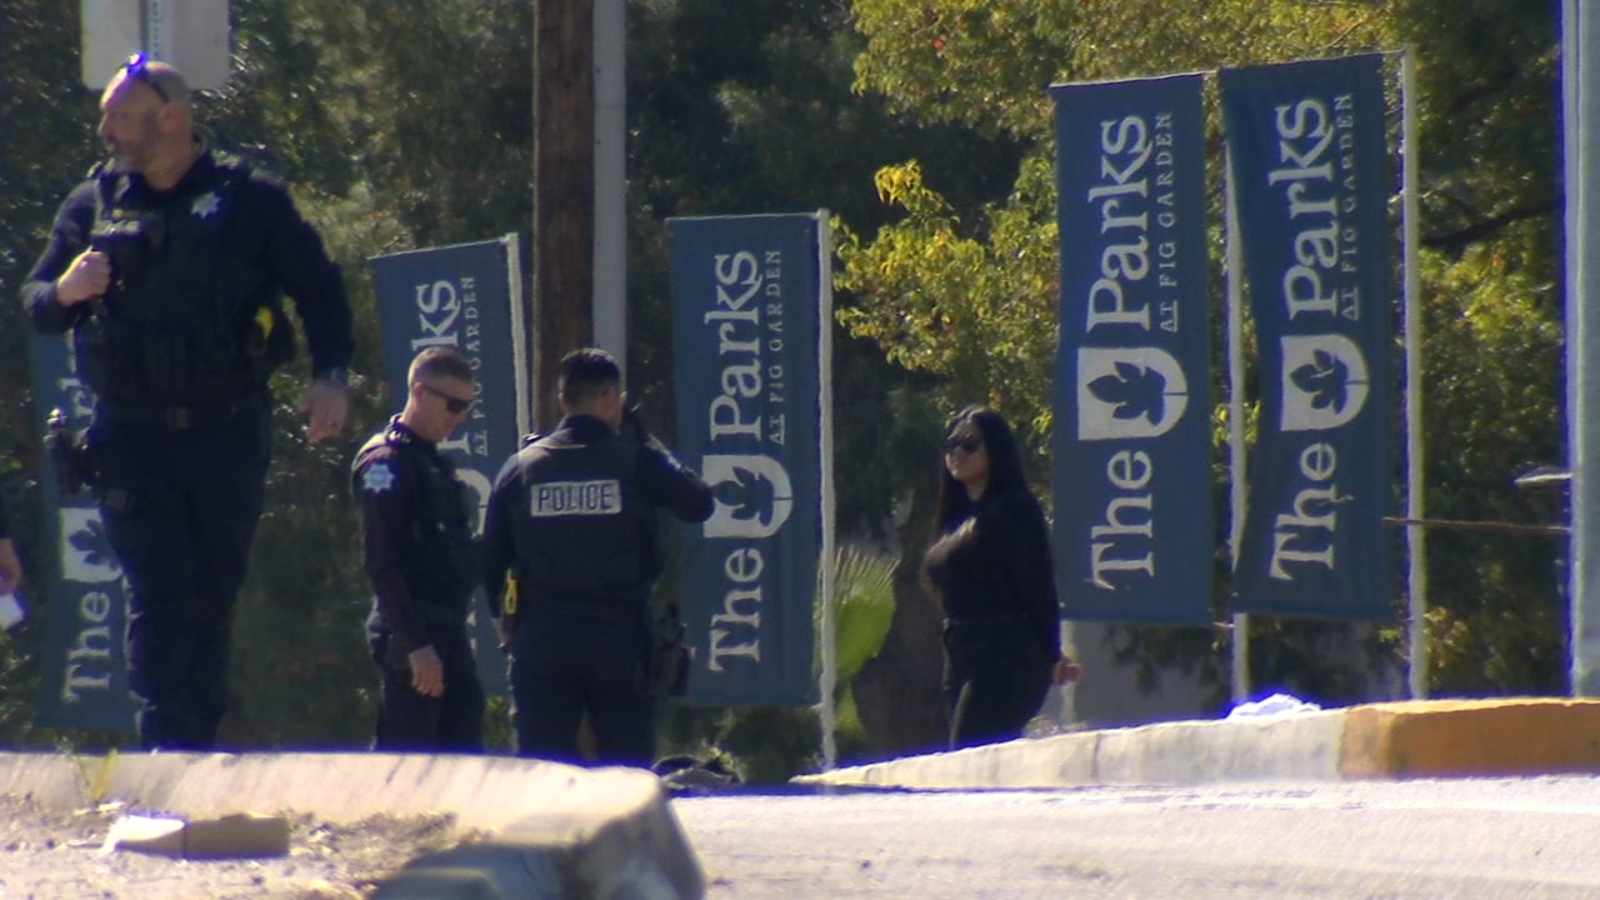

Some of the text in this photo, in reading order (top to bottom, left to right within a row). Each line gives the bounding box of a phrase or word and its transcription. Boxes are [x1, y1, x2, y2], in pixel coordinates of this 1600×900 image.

[1155, 112, 1178, 333] AT FIG GARDEN
[1335, 94, 1360, 321] AT FIG GARDEN
[765, 251, 785, 445] AT FIG GARDEN
[1086, 115, 1154, 590] The Parks
[1268, 99, 1338, 580] The Parks
[538, 484, 614, 512] POLICE
[704, 250, 764, 672] The Parks
[61, 591, 112, 701] The
